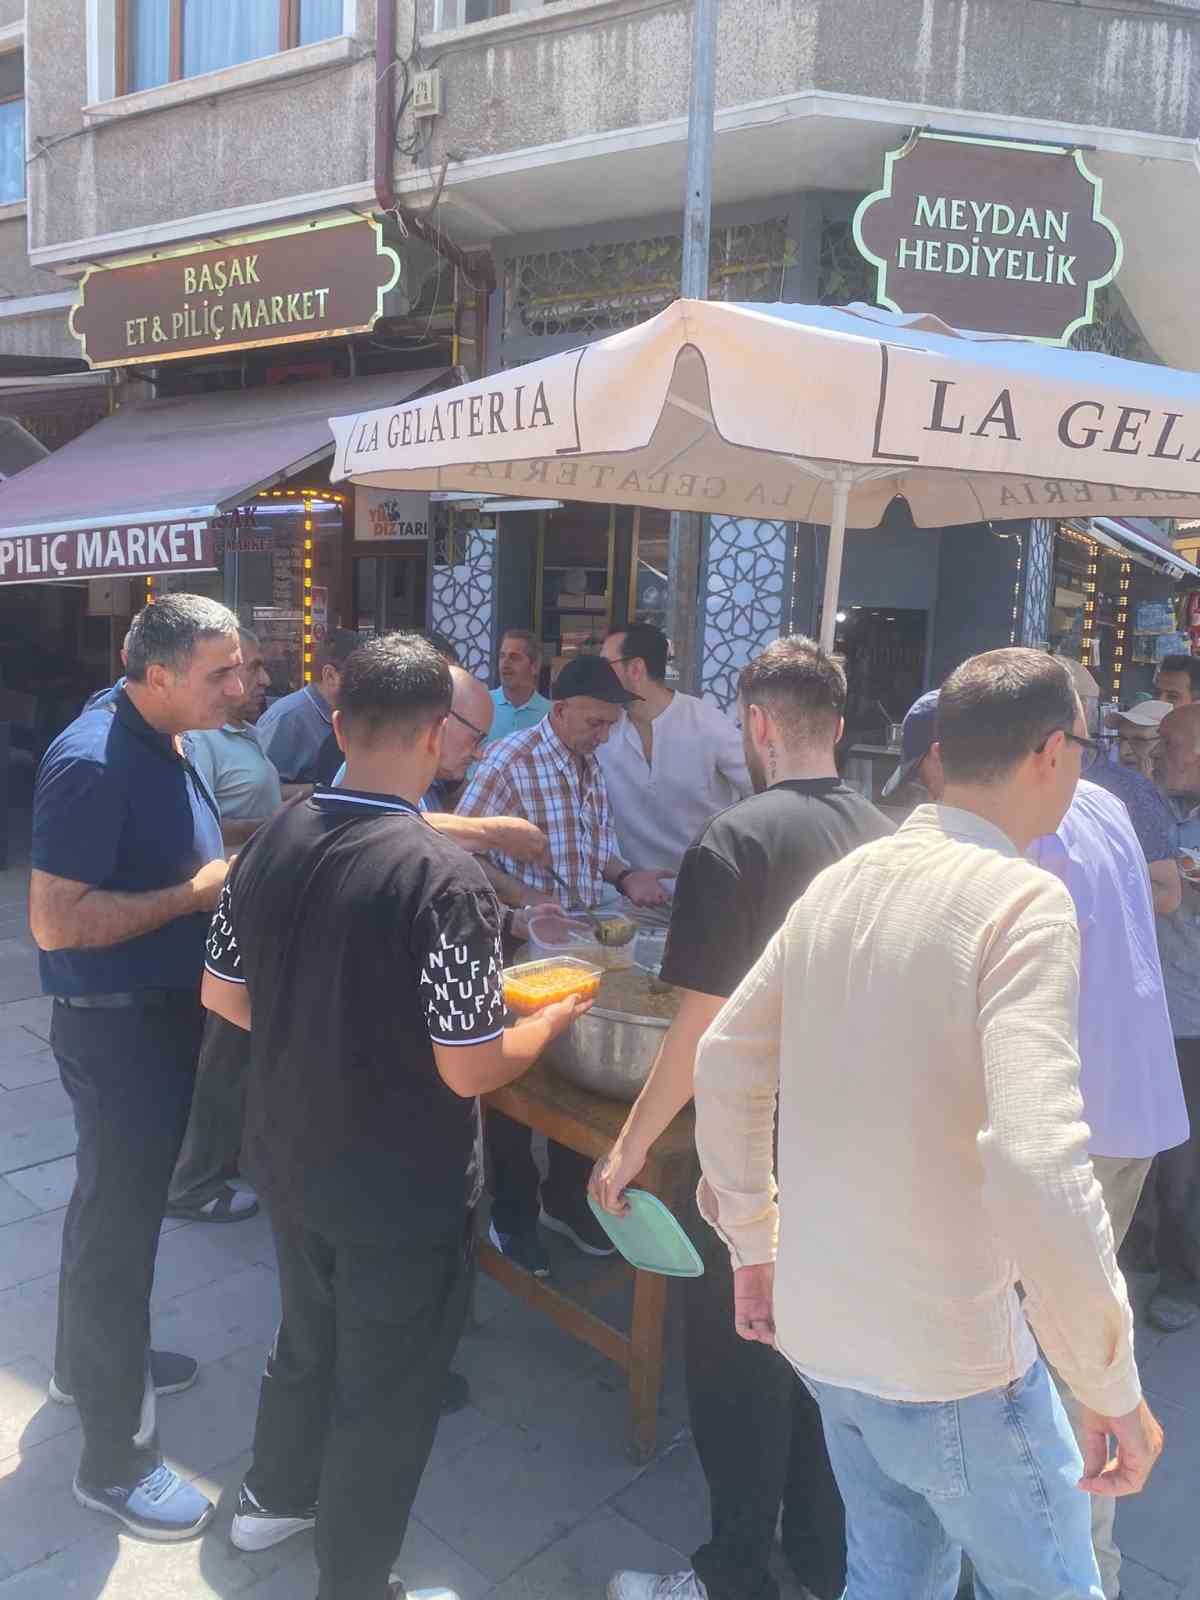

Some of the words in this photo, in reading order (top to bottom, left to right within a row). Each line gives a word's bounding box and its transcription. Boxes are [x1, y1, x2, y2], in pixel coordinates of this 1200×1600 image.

[913, 194, 1071, 243] MEYDAN
[183, 254, 261, 297] BAŞAK
[897, 236, 1077, 286] HEDİYELİK
[125, 316, 148, 346] ET
[151, 315, 168, 342] &
[171, 300, 225, 341] PİLİÇ
[231, 287, 330, 331] MARKET
[356, 420, 378, 453] LA
[387, 380, 555, 449] GELATERIA
[922, 379, 1022, 441] LA
[76, 520, 209, 570] MARKET
